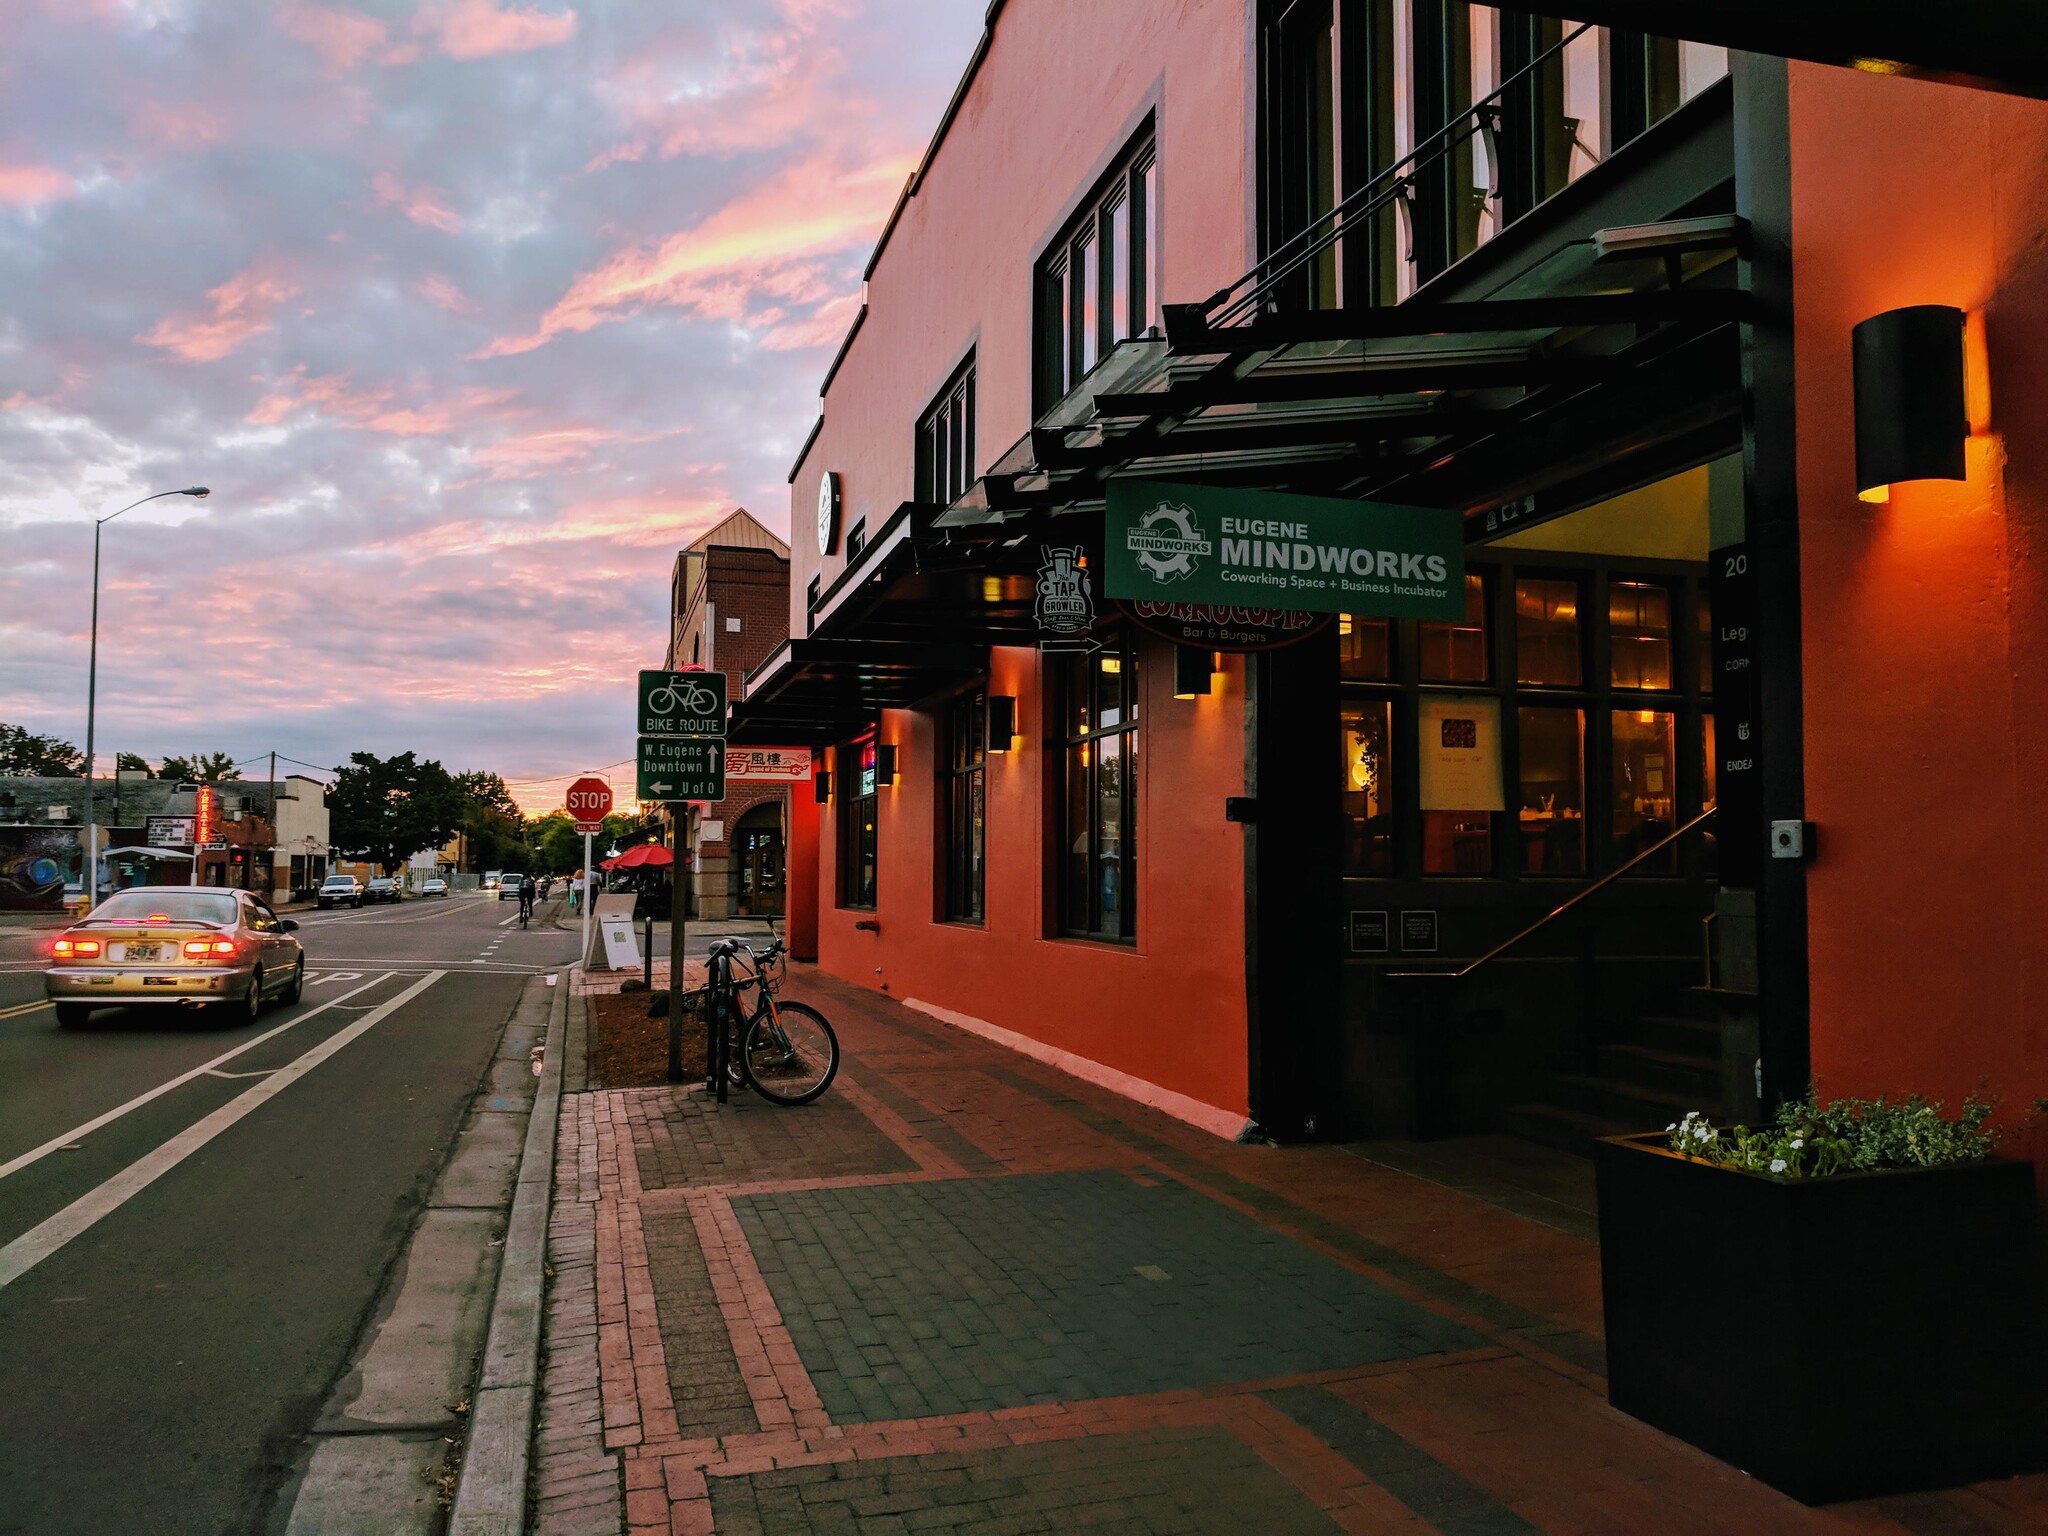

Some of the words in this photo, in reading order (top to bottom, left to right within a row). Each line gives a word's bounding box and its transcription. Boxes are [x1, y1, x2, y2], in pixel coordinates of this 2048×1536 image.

[1130, 529, 1157, 537] EUGENE
[1221, 517, 1308, 540] EUGENE
[1130, 538, 1209, 553] MINDWORKS
[1221, 537, 1448, 583] MINDWORKS
[1052, 582, 1075, 596] TAP
[1220, 570, 1287, 589] Coworking
[1290, 575, 1326, 589] Space
[1329, 580, 1338, 588] +
[1341, 579, 1391, 594] Business
[1393, 583, 1448, 598] Incubator
[1045, 601, 1084, 612] GROWLER
[1182, 626, 1204, 638] Bar
[1207, 627, 1216, 638] &
[1219, 629, 1267, 643] Burgers
[646, 719, 673, 731] BIKE
[679, 719, 719, 732] ROUTE
[645, 744, 656, 756] W.
[659, 744, 702, 758] Eugene
[644, 760, 703, 773] Downtown
[682, 782, 689, 794] U
[693, 782, 704, 793] of
[708, 782, 715, 794] O
[569, 791, 610, 809] STOP
[200, 788, 210, 842] THEATER
